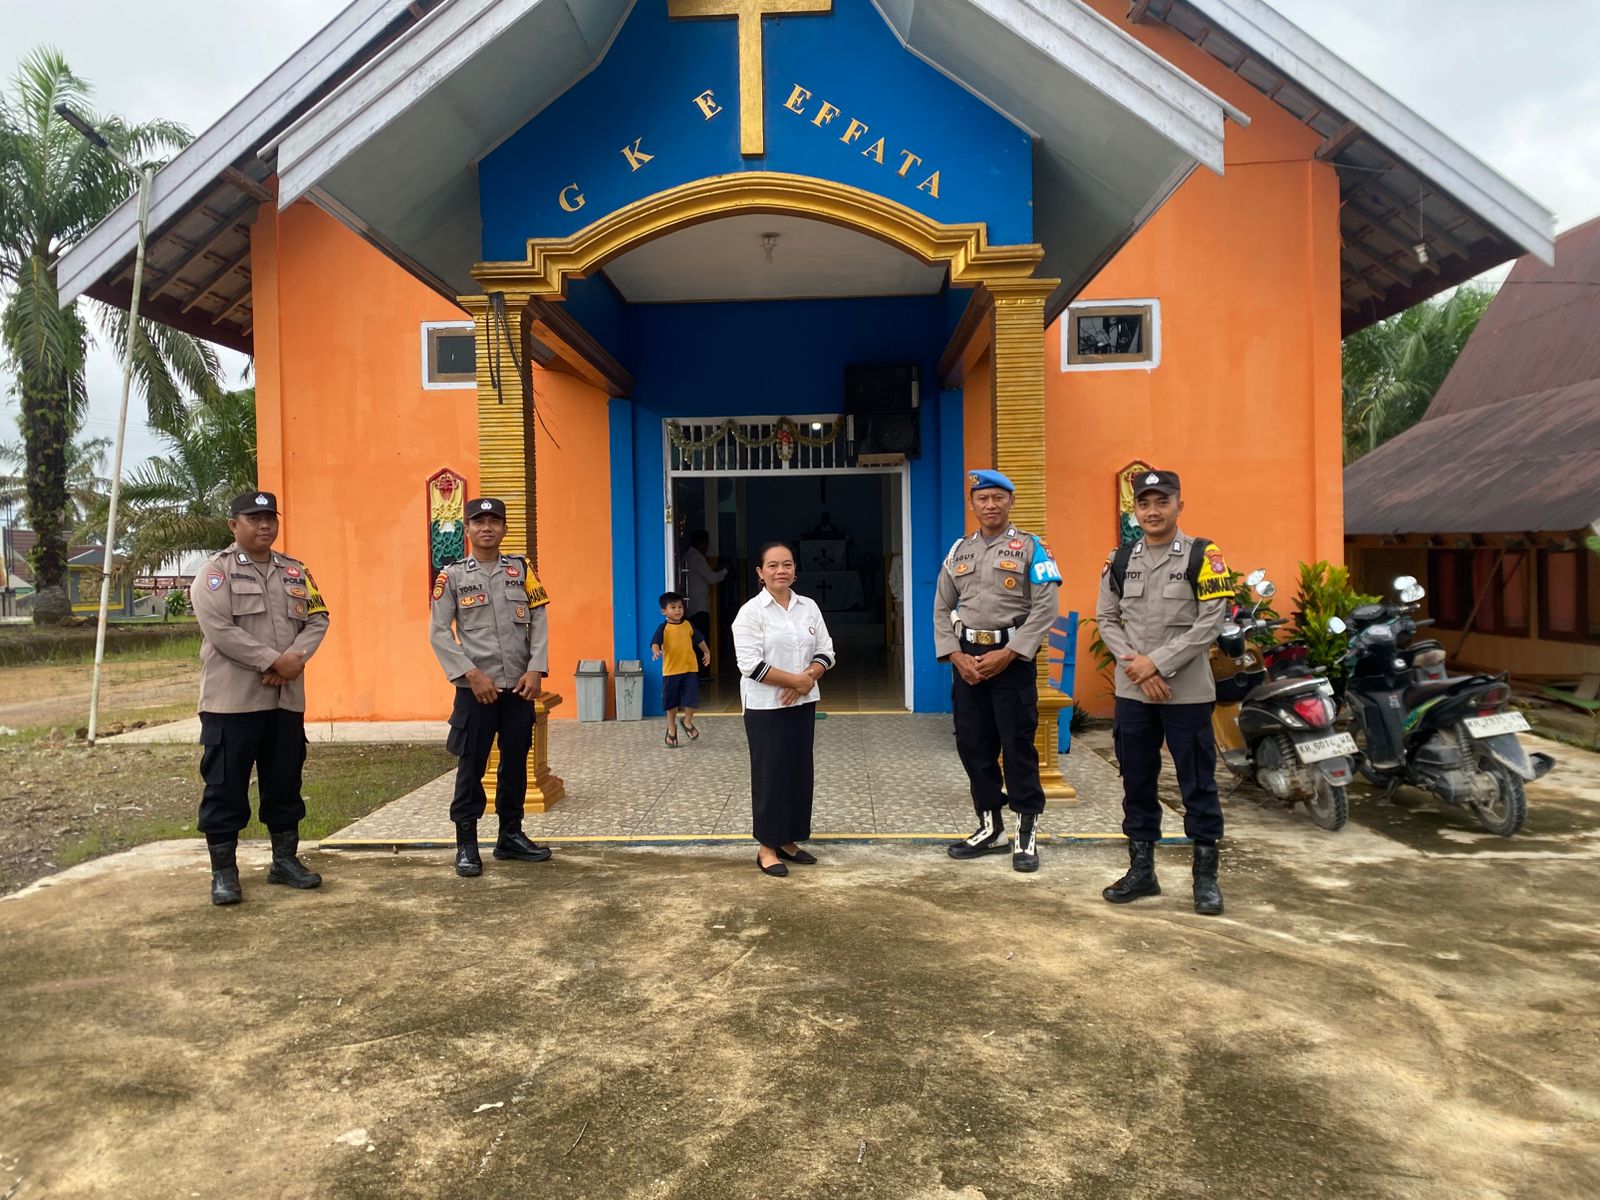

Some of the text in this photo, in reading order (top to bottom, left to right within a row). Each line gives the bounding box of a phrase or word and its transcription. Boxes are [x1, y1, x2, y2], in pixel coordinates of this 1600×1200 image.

[558, 83, 941, 213] G K E EFFATA
[998, 549, 1024, 558] POLRI
[1034, 560, 1062, 581] PR
[1125, 571, 1142, 580] TOT
[1299, 744, 1312, 753] KH
